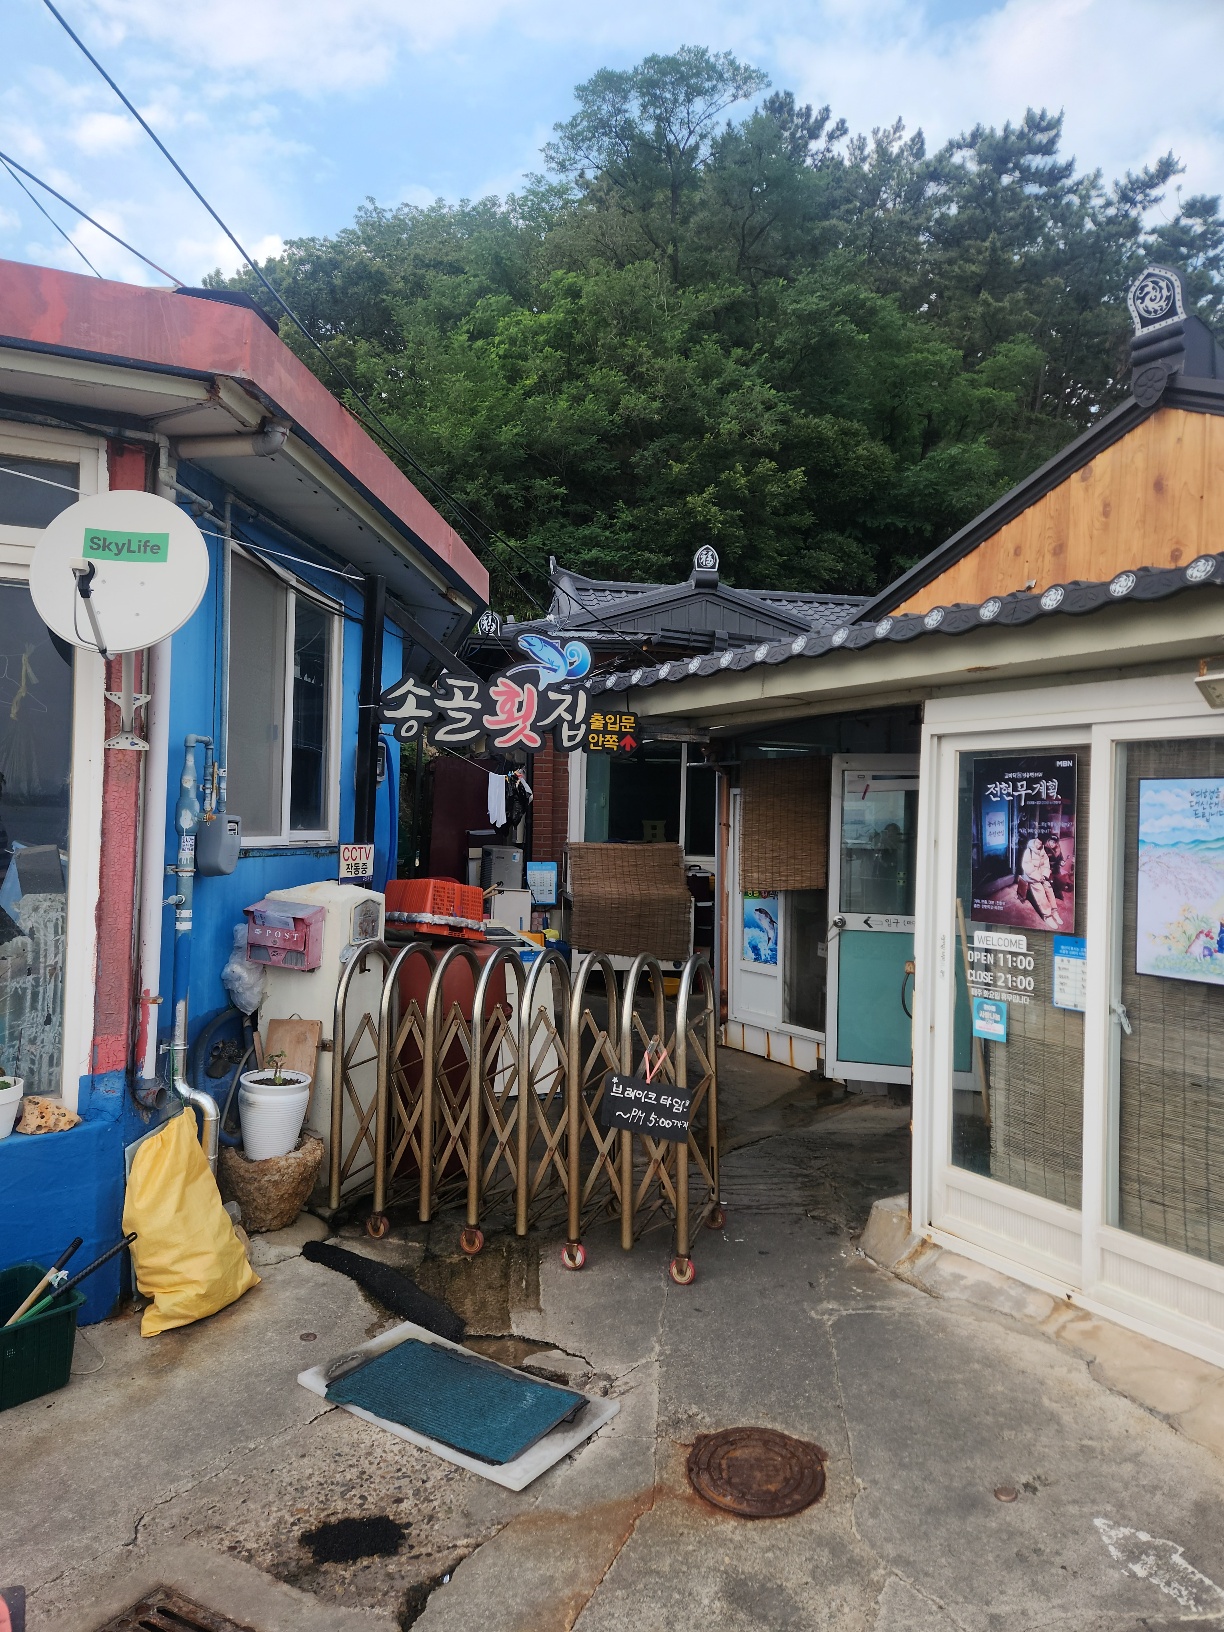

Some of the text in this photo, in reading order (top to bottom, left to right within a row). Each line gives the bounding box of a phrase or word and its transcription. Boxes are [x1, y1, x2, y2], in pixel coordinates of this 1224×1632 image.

[89, 536, 161, 556] SkyLife
[384, 677, 587, 748] 송골횟집
[589, 712, 636, 732] 출입문
[589, 734, 619, 751] 안쪽
[343, 846, 371, 861] CCTV
[346, 863, 368, 875] 작동중
[884, 918, 900, 928] 입구
[266, 929, 298, 940] POST
[977, 935, 1024, 949] WELCOME
[967, 950, 1034, 970] OPEN 11:00
[967, 970, 1034, 990] CLOSE 21:00
[983, 990, 1001, 1000] 화요일
[1001, 992, 1030, 1004] 휴무입니다
[610, 1083, 657, 1104] 브레이크
